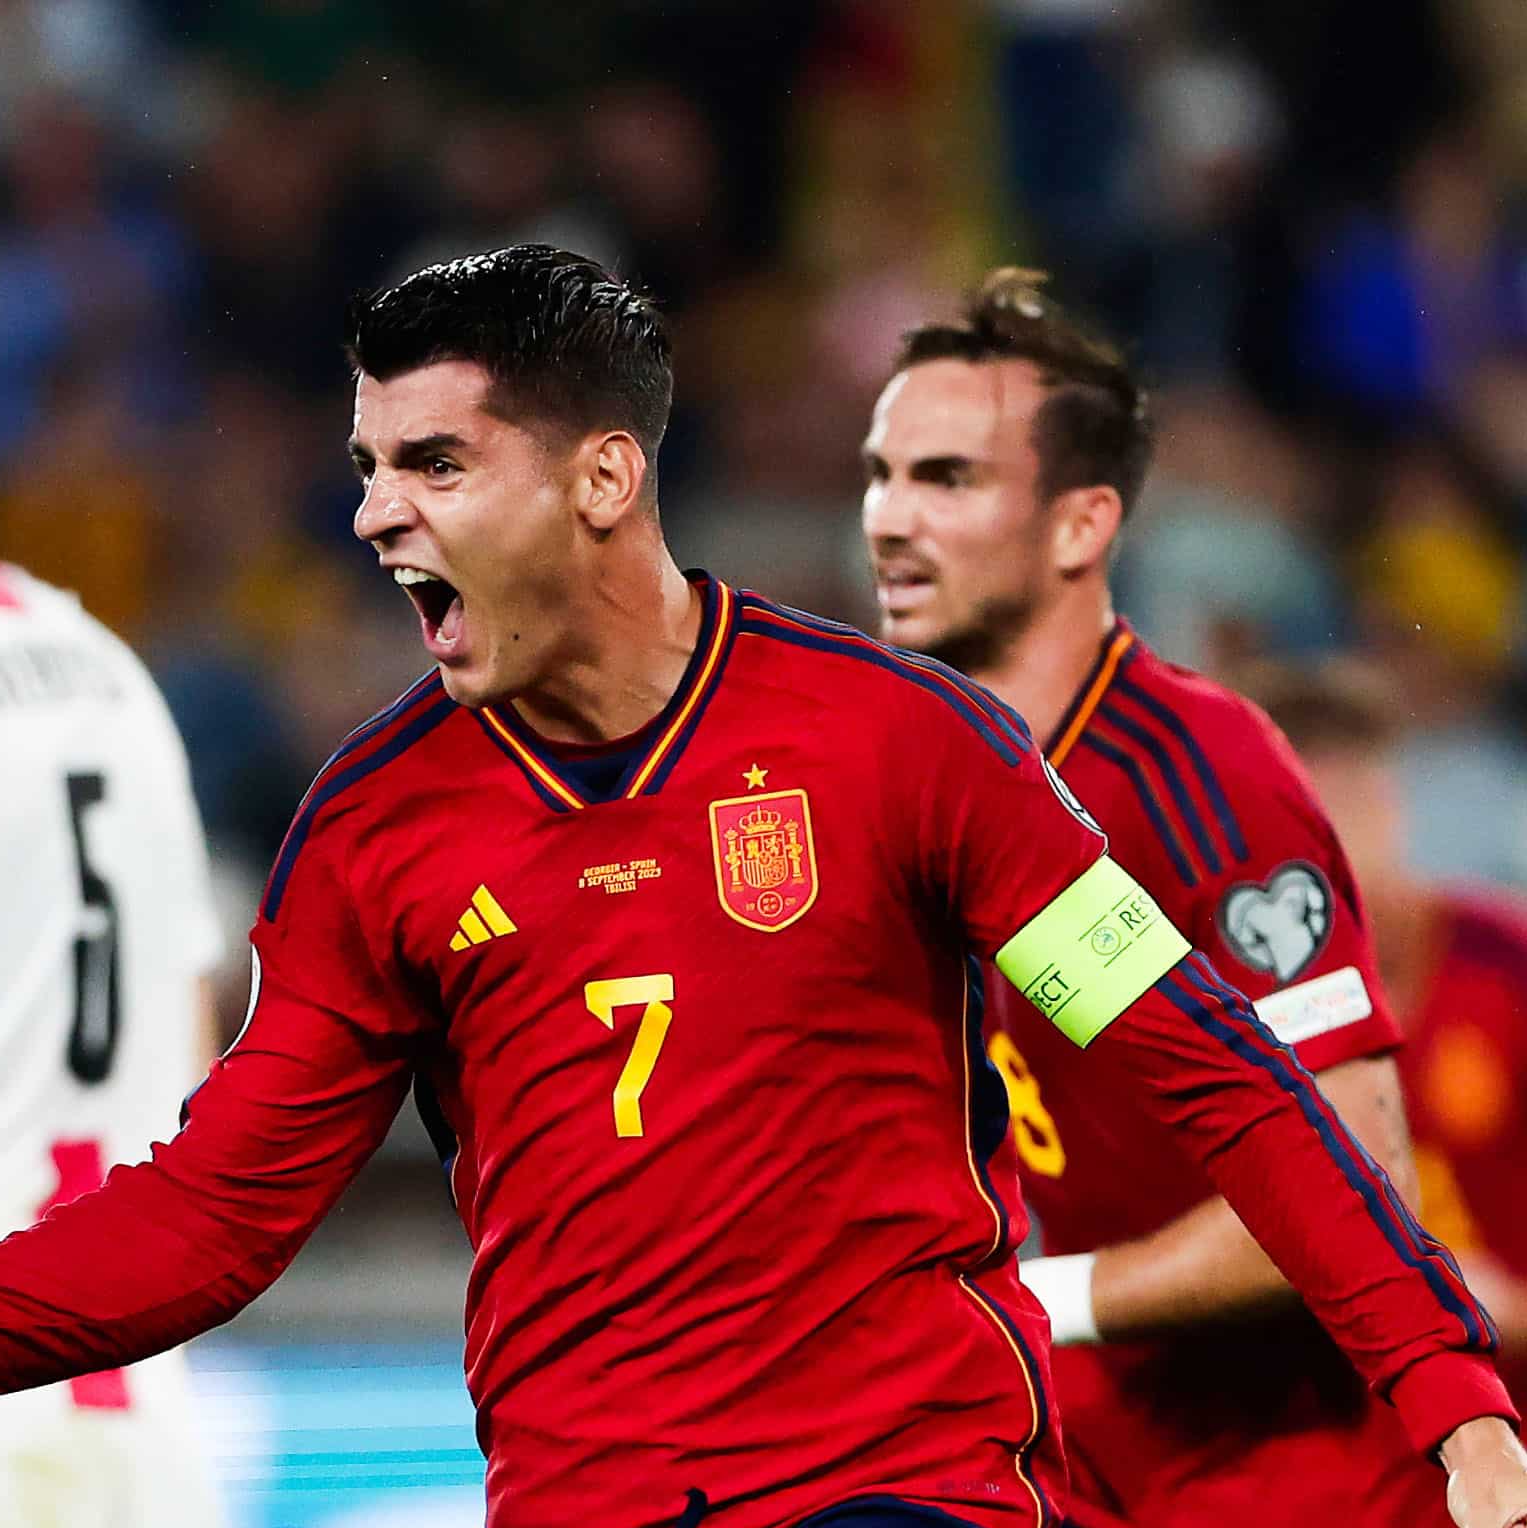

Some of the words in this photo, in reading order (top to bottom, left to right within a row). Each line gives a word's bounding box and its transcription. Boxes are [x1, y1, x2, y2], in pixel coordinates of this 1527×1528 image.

[584, 863, 620, 878] GEORGIA
[629, 859, 657, 870] SPAIN
[587, 871, 636, 887] SEPTEMBER
[637, 867, 662, 879] 2023
[604, 881, 637, 894] TBILISI
[64, 769, 123, 1084] 5
[584, 973, 674, 1138] 7
[987, 1031, 1067, 1178] 8
